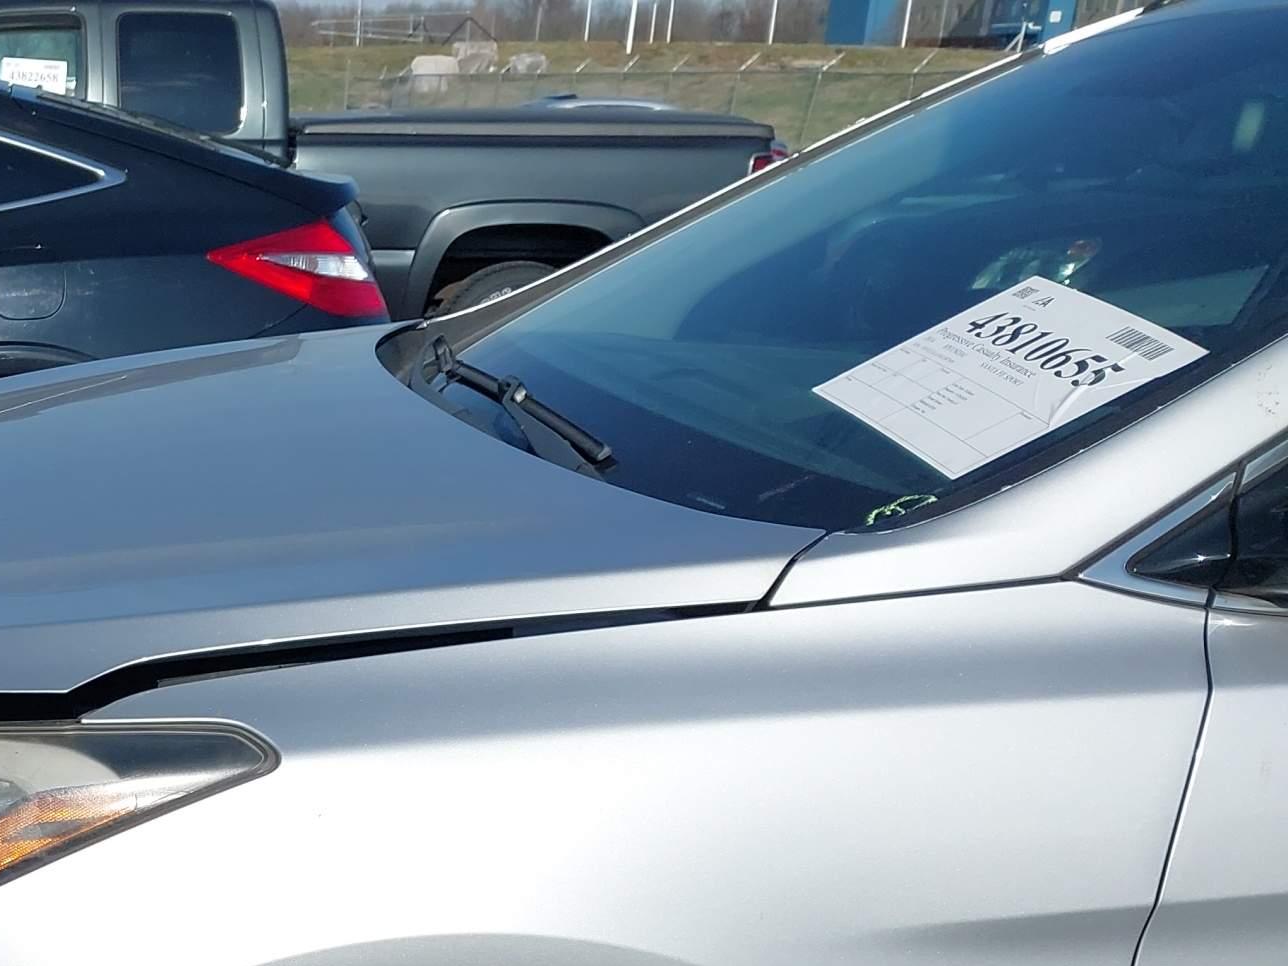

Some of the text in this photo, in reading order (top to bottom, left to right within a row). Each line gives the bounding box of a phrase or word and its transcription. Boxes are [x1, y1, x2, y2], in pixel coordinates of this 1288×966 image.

[936, 327, 975, 350] Progressive
[972, 342, 1003, 363] Casualty
[999, 356, 1037, 378] Insurance
[965, 311, 1126, 387] 43810655
